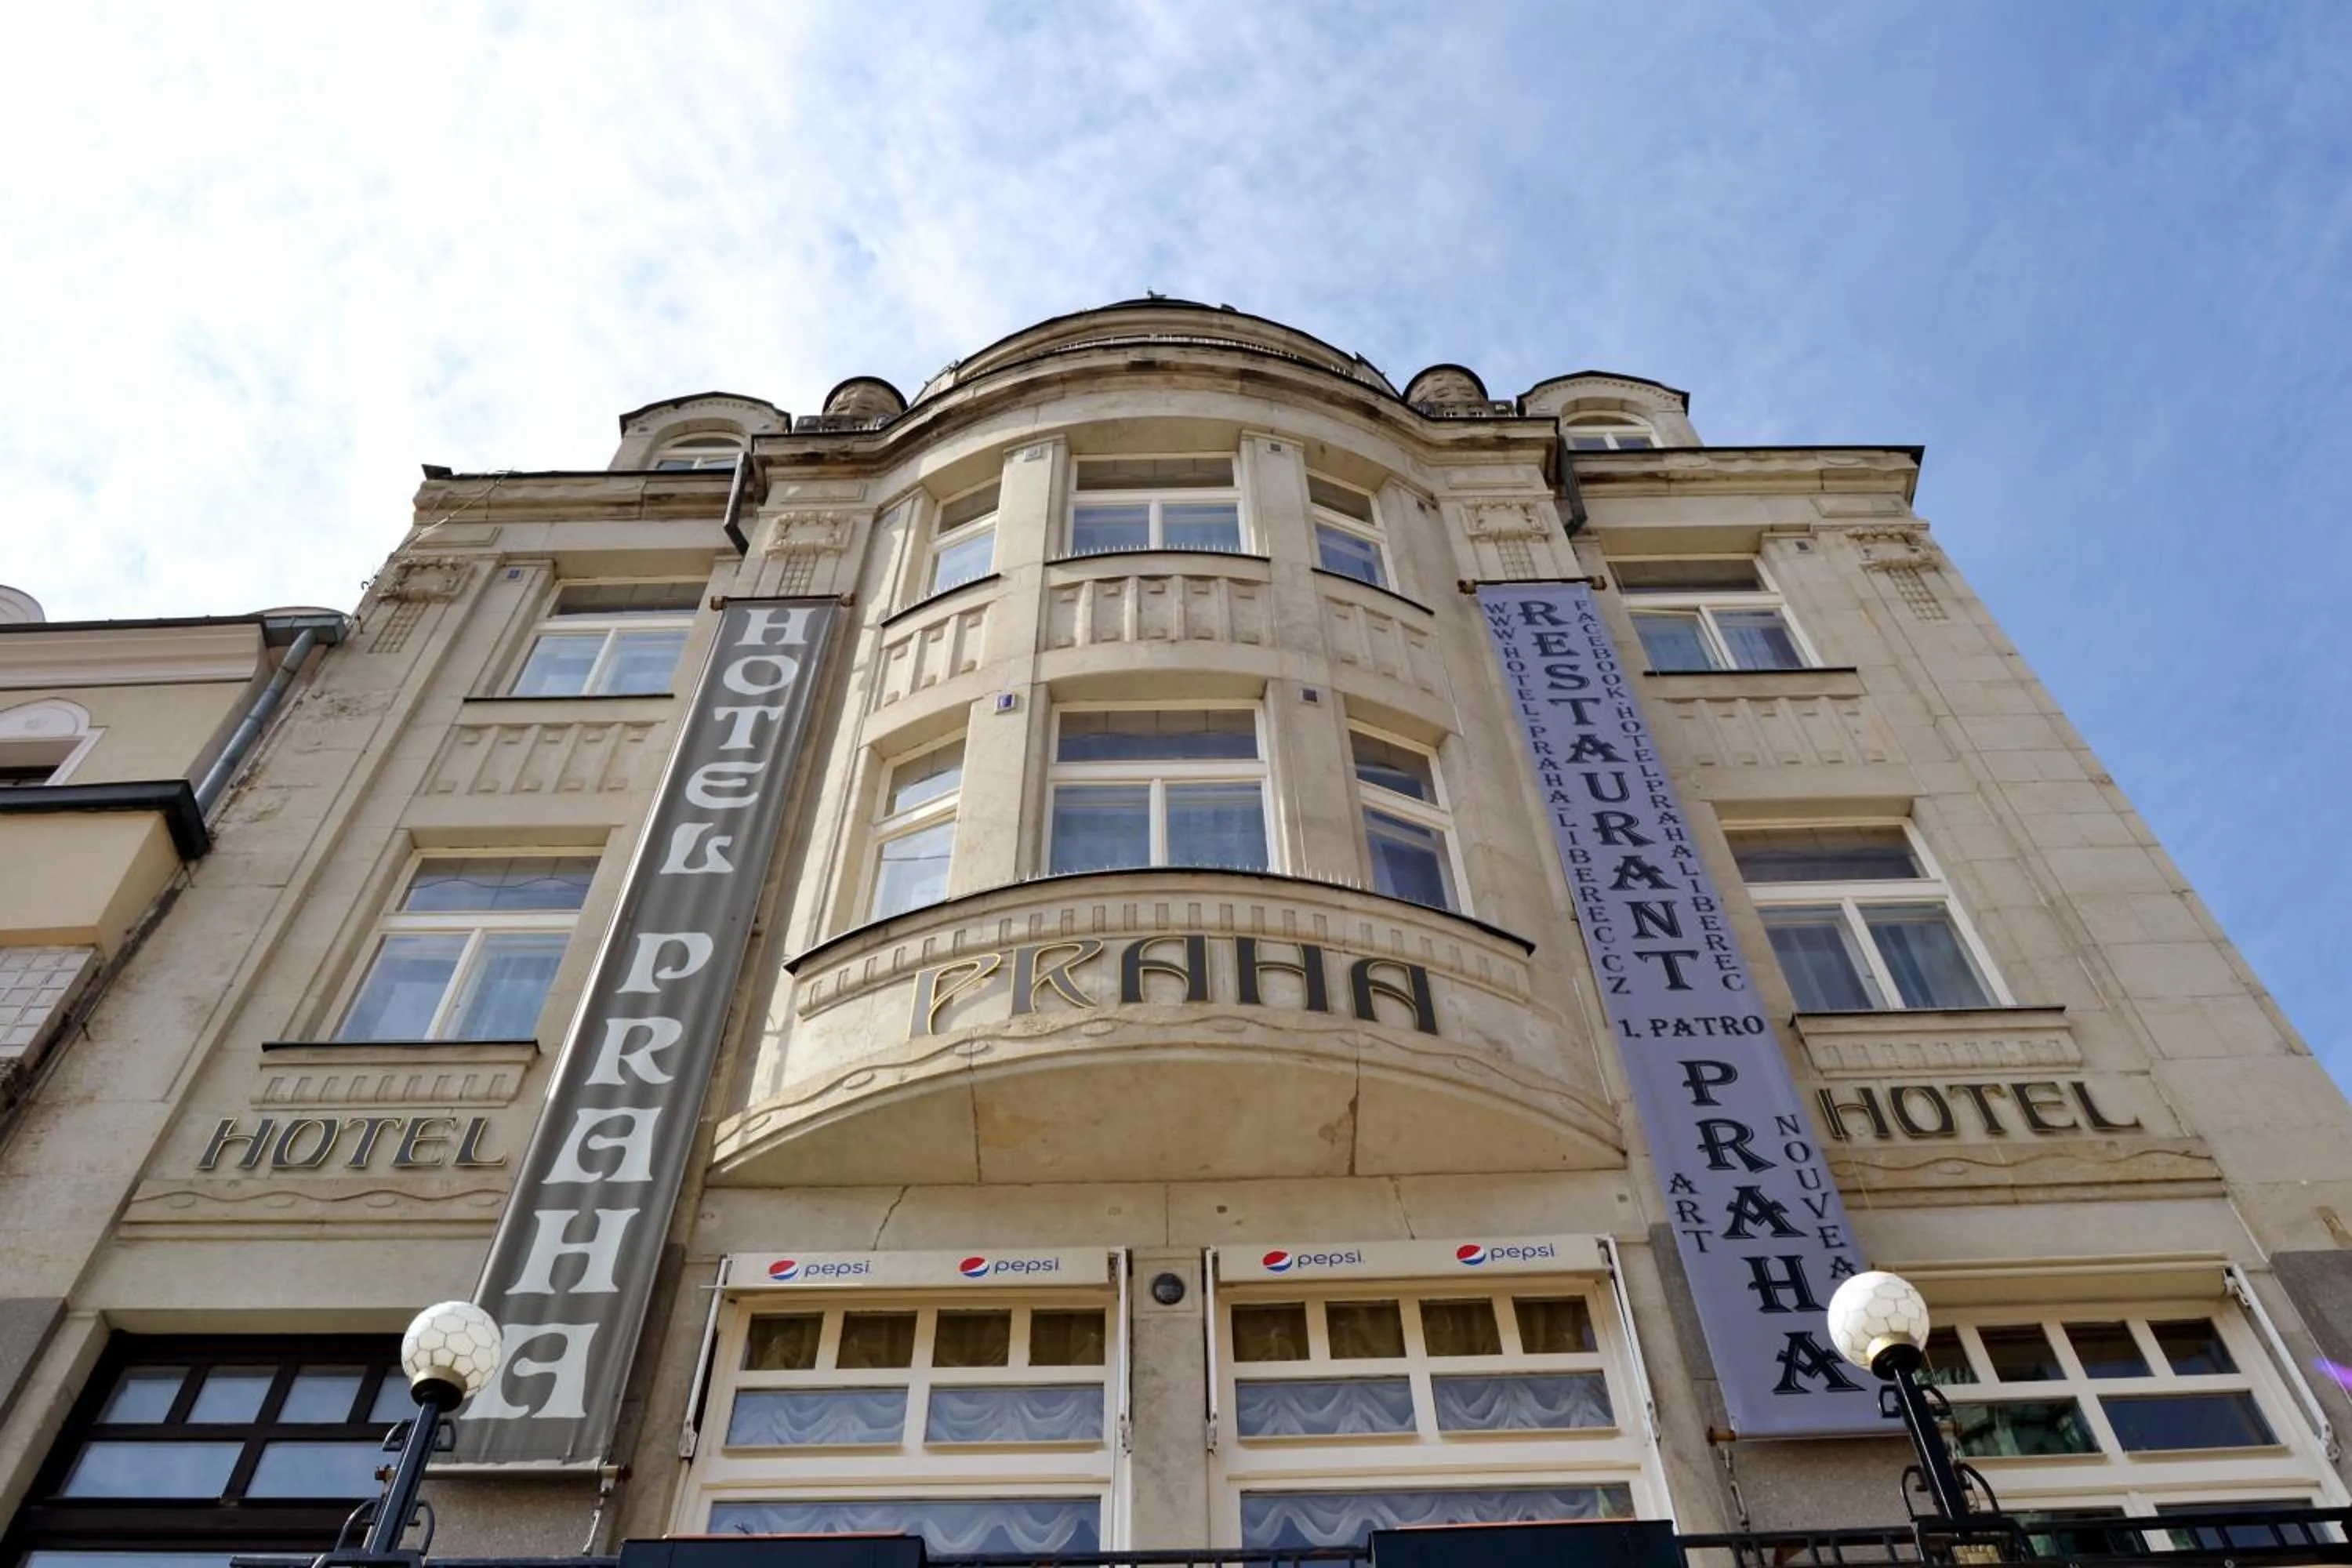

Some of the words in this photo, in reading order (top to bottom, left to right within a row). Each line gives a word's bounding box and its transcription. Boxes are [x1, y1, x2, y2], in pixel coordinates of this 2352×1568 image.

[659, 608, 816, 874] HOTEL
[1485, 601, 1631, 994] WWW.HOTEL-PRAHA-LIBEREC.CZ
[1518, 601, 1700, 990] RESTAURANT
[908, 934, 1438, 1040] PRAHA
[1619, 1019, 1641, 1039] 1.
[1650, 1015, 1765, 1039] PATRO
[197, 1116, 507, 1170] HOTEL
[1817, 1080, 2143, 1140] HOTEL
[460, 931, 713, 1420] PRAHA
[1668, 1172, 1713, 1254] ART
[1773, 1113, 1857, 1280] NOUVEA
[804, 1260, 871, 1277] pepsi
[994, 1258, 1060, 1274] pepsi
[1298, 1249, 1362, 1268] pepsi
[1490, 1243, 1555, 1261] pepsi
[1678, 1060, 1867, 1394] PRAHA
